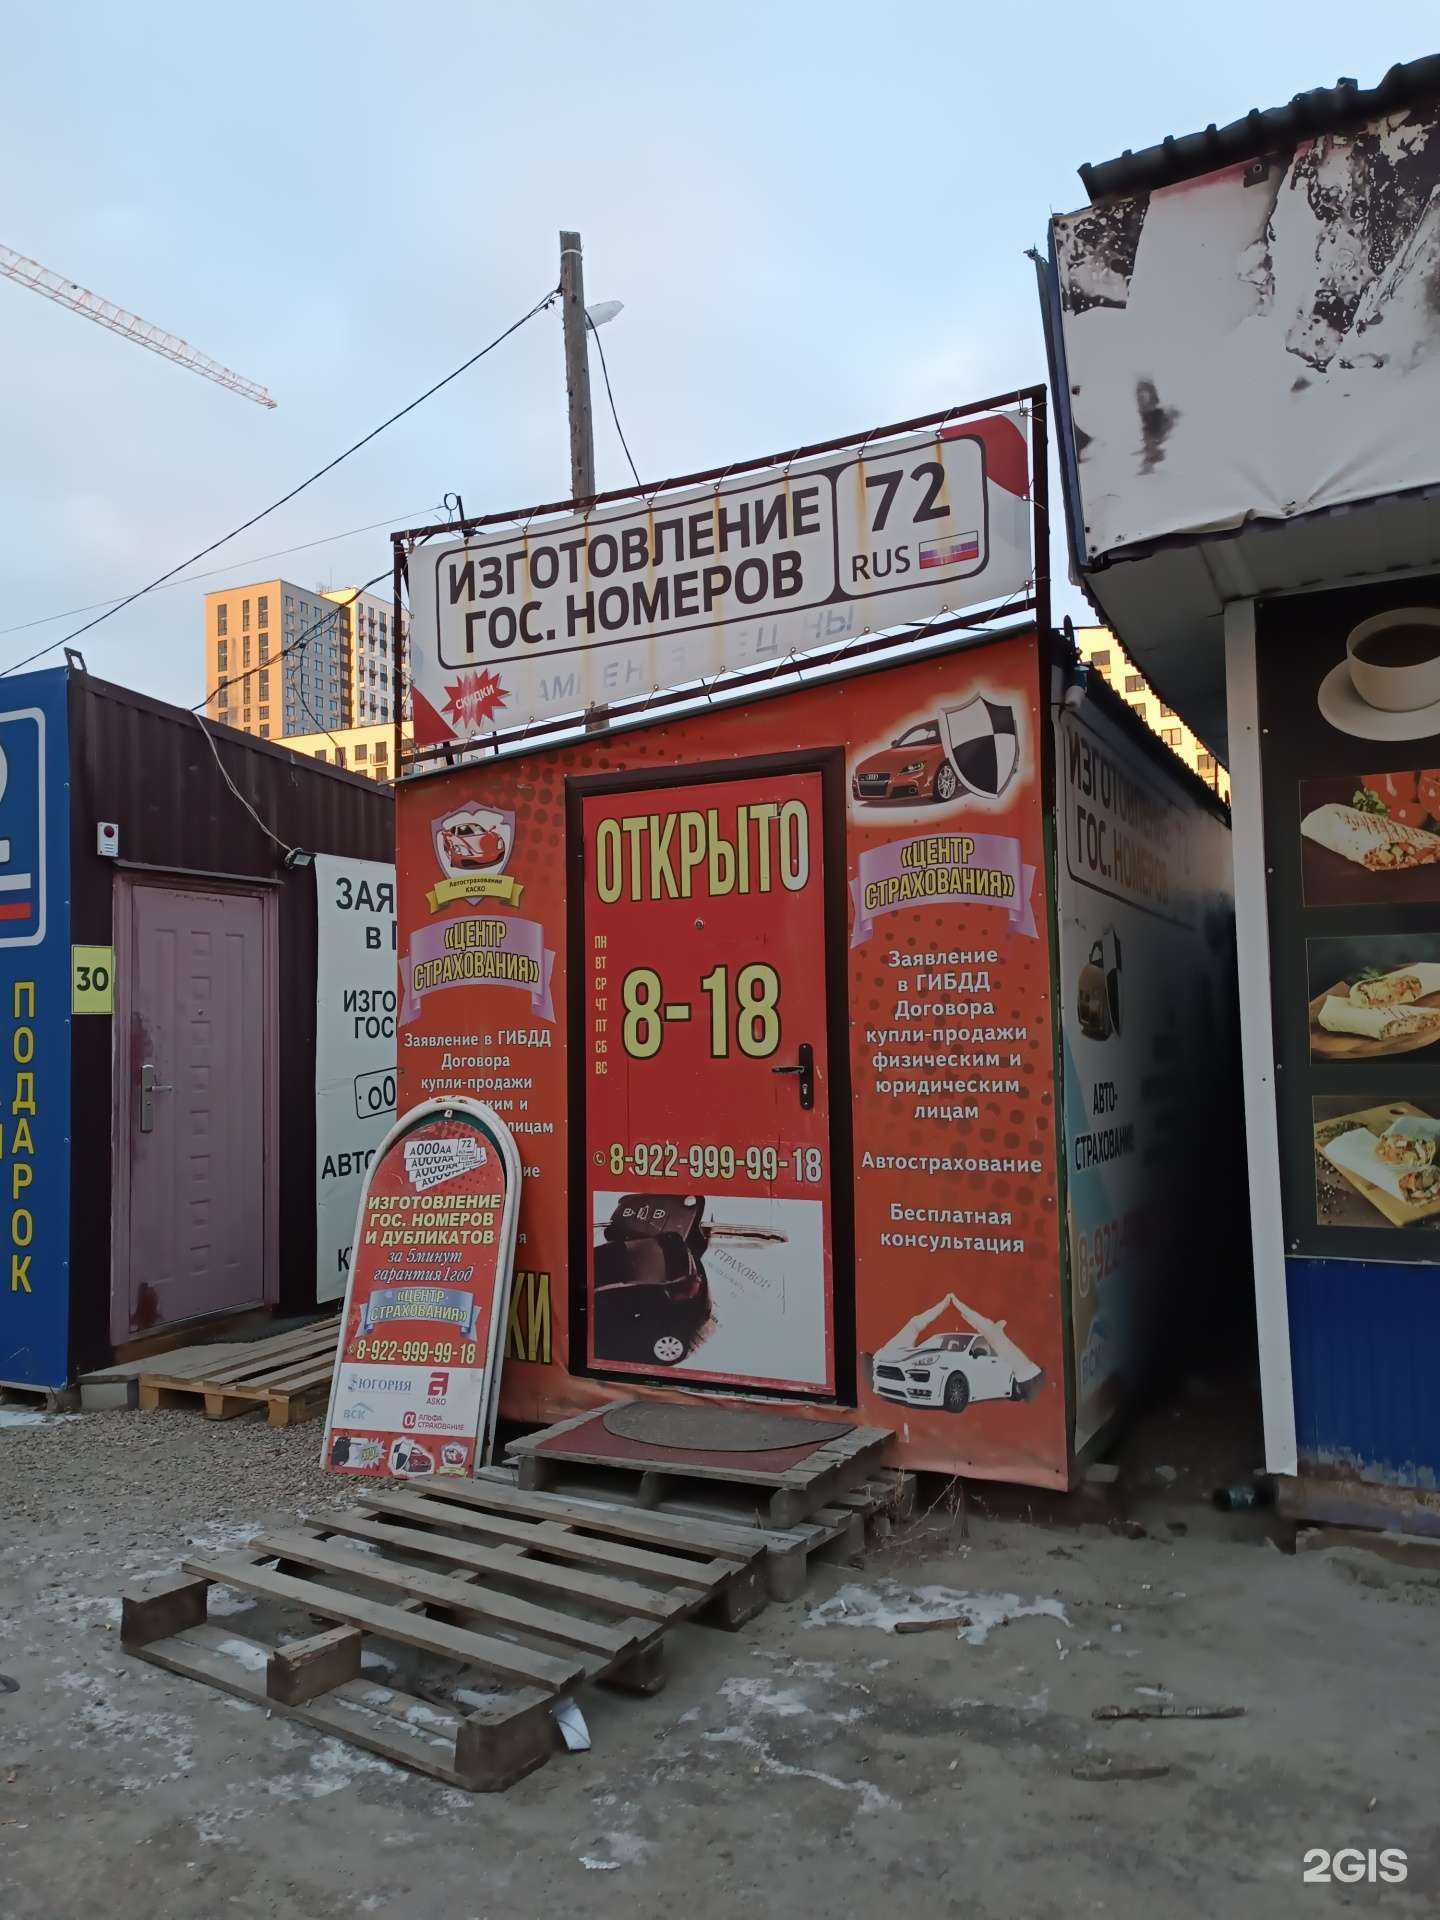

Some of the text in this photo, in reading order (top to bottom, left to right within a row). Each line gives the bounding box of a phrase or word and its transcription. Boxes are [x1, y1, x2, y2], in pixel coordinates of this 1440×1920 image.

[866, 462, 951, 533] 72
[449, 485, 822, 606] ИЗГОТОВЛЕНИЕ
[852, 544, 911, 583] RUS
[465, 551, 804, 654] ГОС. НОМЕРОВ
[595, 799, 810, 904] ОТКРЫТО
[901, 836, 975, 869] «ЦЕНТР
[465, 885, 486, 893] КАСКО
[864, 866, 1015, 910] СТРАХОВАНИЯ»
[444, 919, 507, 951] «ЦЕНТР
[594, 935, 607, 949] ПН
[595, 956, 607, 969] ВТ
[888, 950, 999, 968] Заявление
[76, 966, 109, 992] 30
[413, 951, 540, 991] СТРАХОВАНИЯ»
[595, 977, 607, 990] СР
[898, 971, 991, 993] в ГИБДД
[595, 998, 607, 1011] ЧТ
[894, 1000, 995, 1020] Договора
[595, 1019, 607, 1032] ПТ
[404, 1030, 552, 1048] Заявление в ГИБДД
[866, 1026, 1027, 1047] купли-продажи
[595, 1040, 607, 1053] СБ
[441, 1053, 511, 1071] Договора
[595, 1061, 608, 1074] ВС
[872, 1051, 1021, 1071] физическим и
[421, 1076, 532, 1092] купли-продажи
[875, 1078, 1020, 1097] юридическим
[914, 1105, 979, 1122] лицам
[11, 981, 37, 1294] ПОДАРОК
[461, 1140, 472, 1148] 72
[608, 1142, 823, 1183] 8-922-999-99-18
[861, 1151, 1043, 1174] Автострахование
[367, 1194, 501, 1210] ИЗГОТОВЛЕНИЕ
[370, 1212, 494, 1227] ГОС. НОМЕРОВ
[889, 1203, 1013, 1225] Бесплатная
[365, 1230, 495, 1246] И ДУБЛИКАТОВ
[880, 1232, 1025, 1253] консультация
[387, 1251, 403, 1263] за
[374, 1268, 441, 1284] гарантия
[397, 1288, 445, 1304] «ЦЕНТР
[369, 1304, 468, 1322] СТРАХОВАНИЯ»
[356, 1339, 476, 1365] 8-922-999-99-18
[358, 1378, 412, 1392] ЮГОРИЯ
[417, 1421, 465, 1431] СТРАХОВАНИЕ
